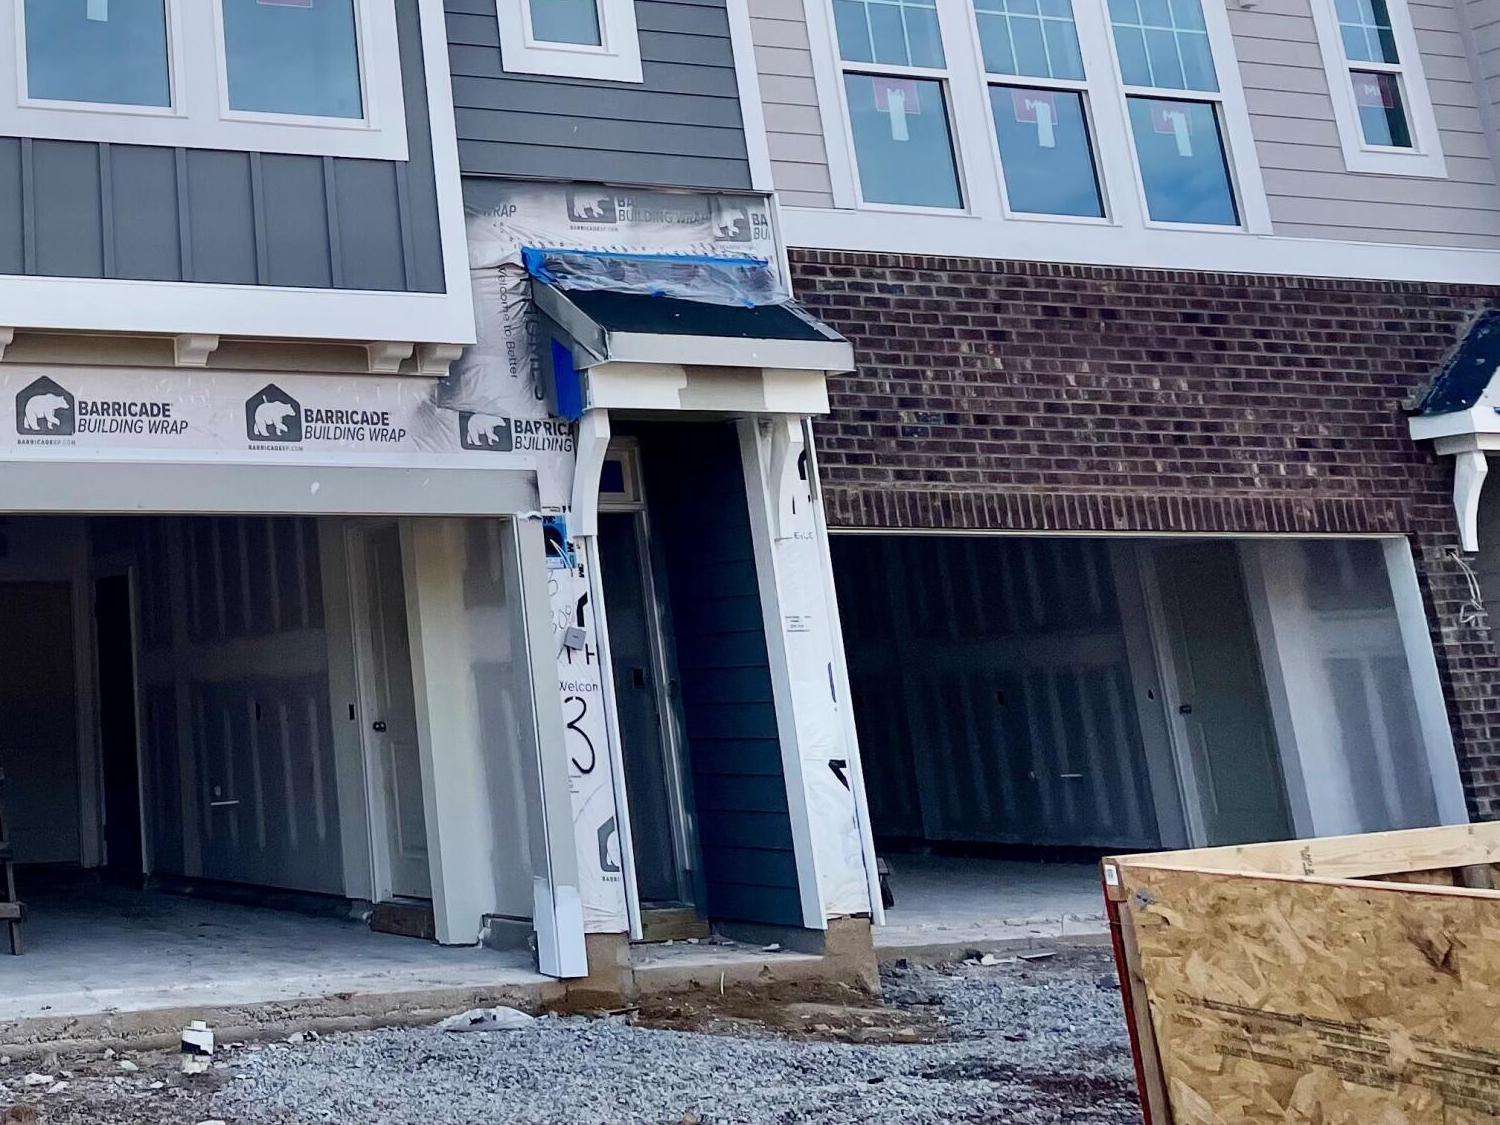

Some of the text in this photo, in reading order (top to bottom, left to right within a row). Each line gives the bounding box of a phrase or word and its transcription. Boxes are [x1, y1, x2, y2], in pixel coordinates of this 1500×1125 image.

[618, 208, 673, 224] BUILDING
[505, 340, 518, 380] Better
[78, 401, 171, 418] BARRICADE
[304, 408, 390, 426] BARRICADE
[77, 418, 189, 435] BUILDING WRAP
[304, 426, 406, 443] BUILDING WRAP
[564, 696, 596, 774] 3
